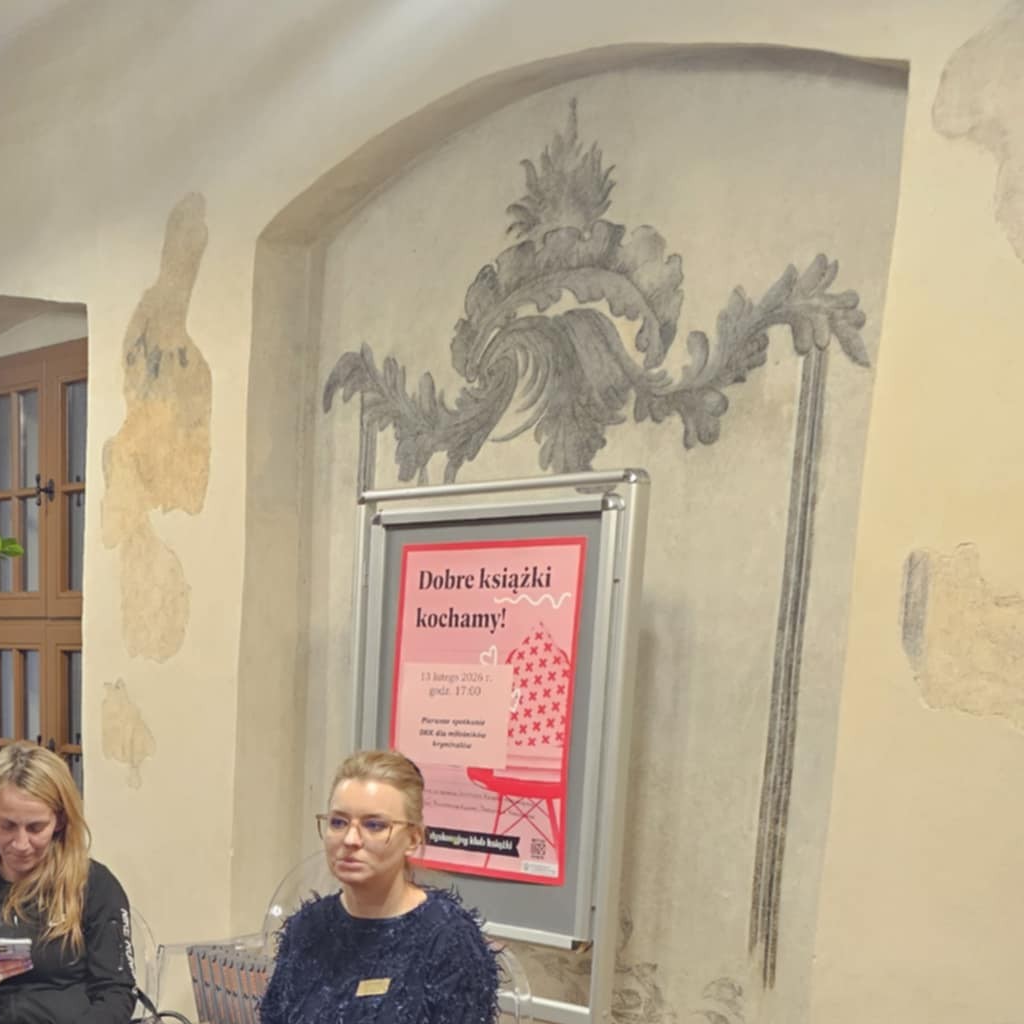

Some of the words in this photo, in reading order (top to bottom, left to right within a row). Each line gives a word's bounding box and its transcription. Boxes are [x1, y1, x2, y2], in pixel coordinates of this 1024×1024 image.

[418, 568, 475, 590] Dobre
[479, 565, 552, 594] książki
[416, 607, 507, 635] kochamy!
[433, 671, 459, 684] lutego
